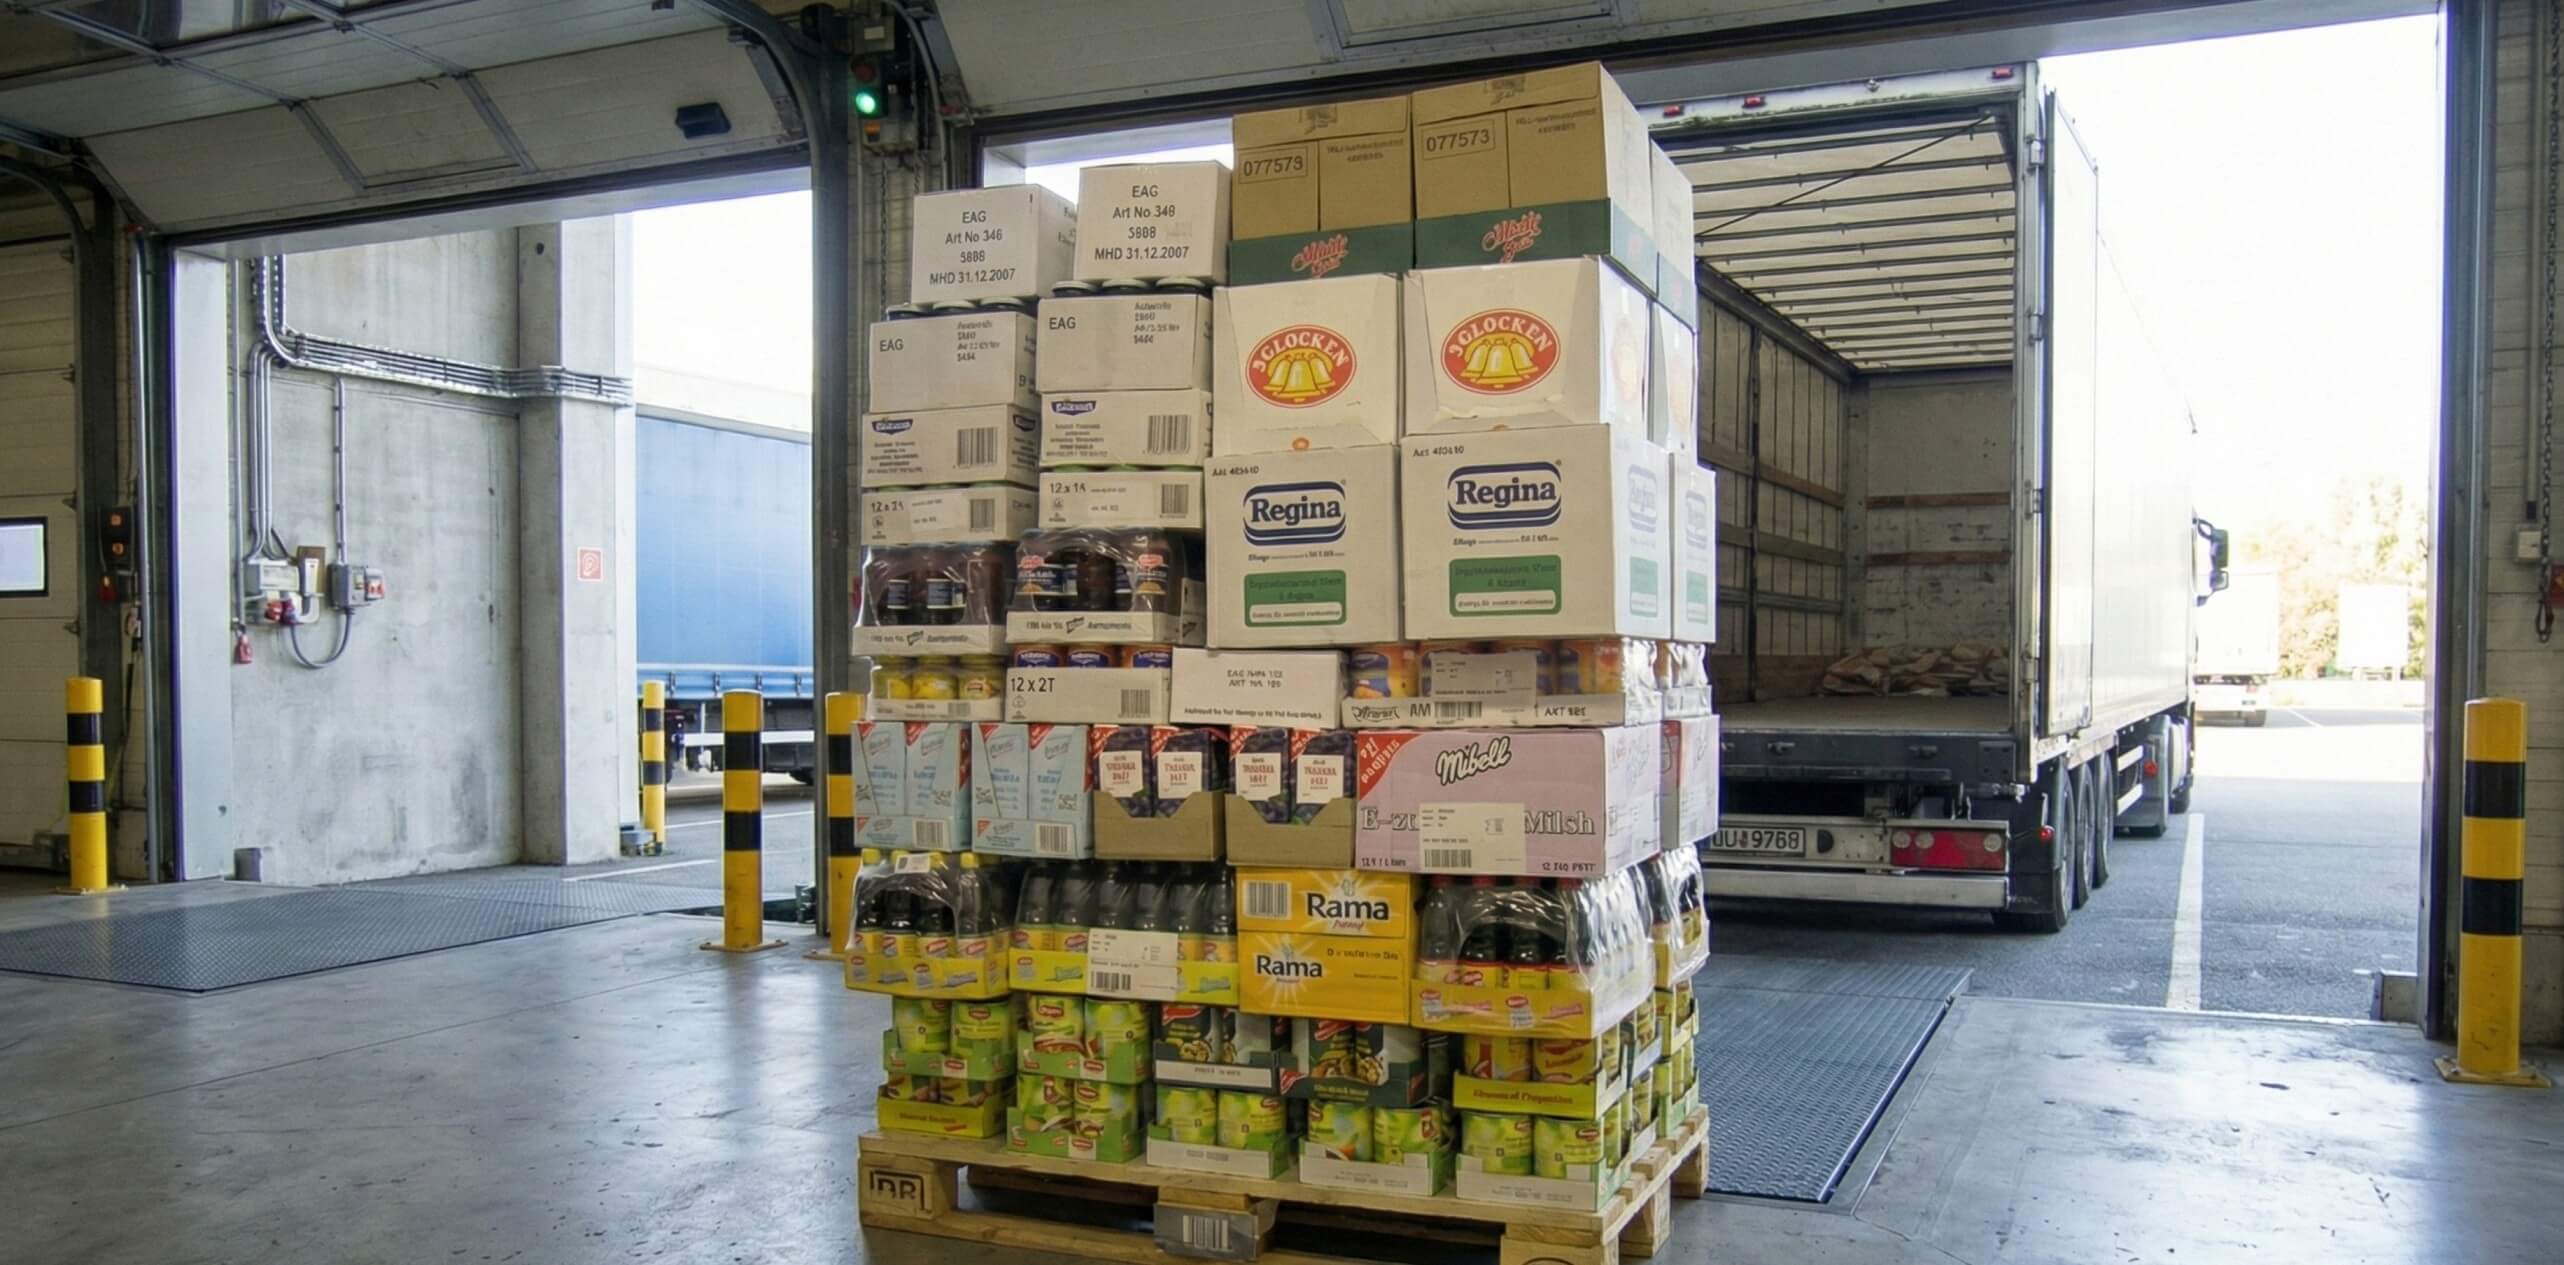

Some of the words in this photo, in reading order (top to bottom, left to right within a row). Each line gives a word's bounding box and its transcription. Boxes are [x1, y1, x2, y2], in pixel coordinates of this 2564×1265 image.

[1426, 129, 1490, 152] 077573
[1131, 185, 1159, 198] EAG
[962, 210, 986, 224] EAG
[1112, 207, 1130, 219] Art
[1134, 206, 1151, 218] No
[945, 233, 962, 245] Art
[965, 231, 980, 243] No
[1095, 248, 1123, 260] MHD
[1126, 246, 1189, 260] 31.12.2007
[929, 271, 955, 285] MHD
[958, 268, 1016, 284] 31.12.2007
[1049, 316, 1077, 330] EAG
[879, 338, 904, 352] EAG
[1455, 477, 1557, 509] Regina
[1250, 495, 1341, 526] Regina
[1011, 677, 1025, 692] 12
[1027, 679, 1036, 692] x
[1435, 735, 1513, 786] Mibell
[1751, 830, 1800, 850] 9768
[1306, 892, 1389, 921] Rama
[1256, 954, 1323, 978] Rama
